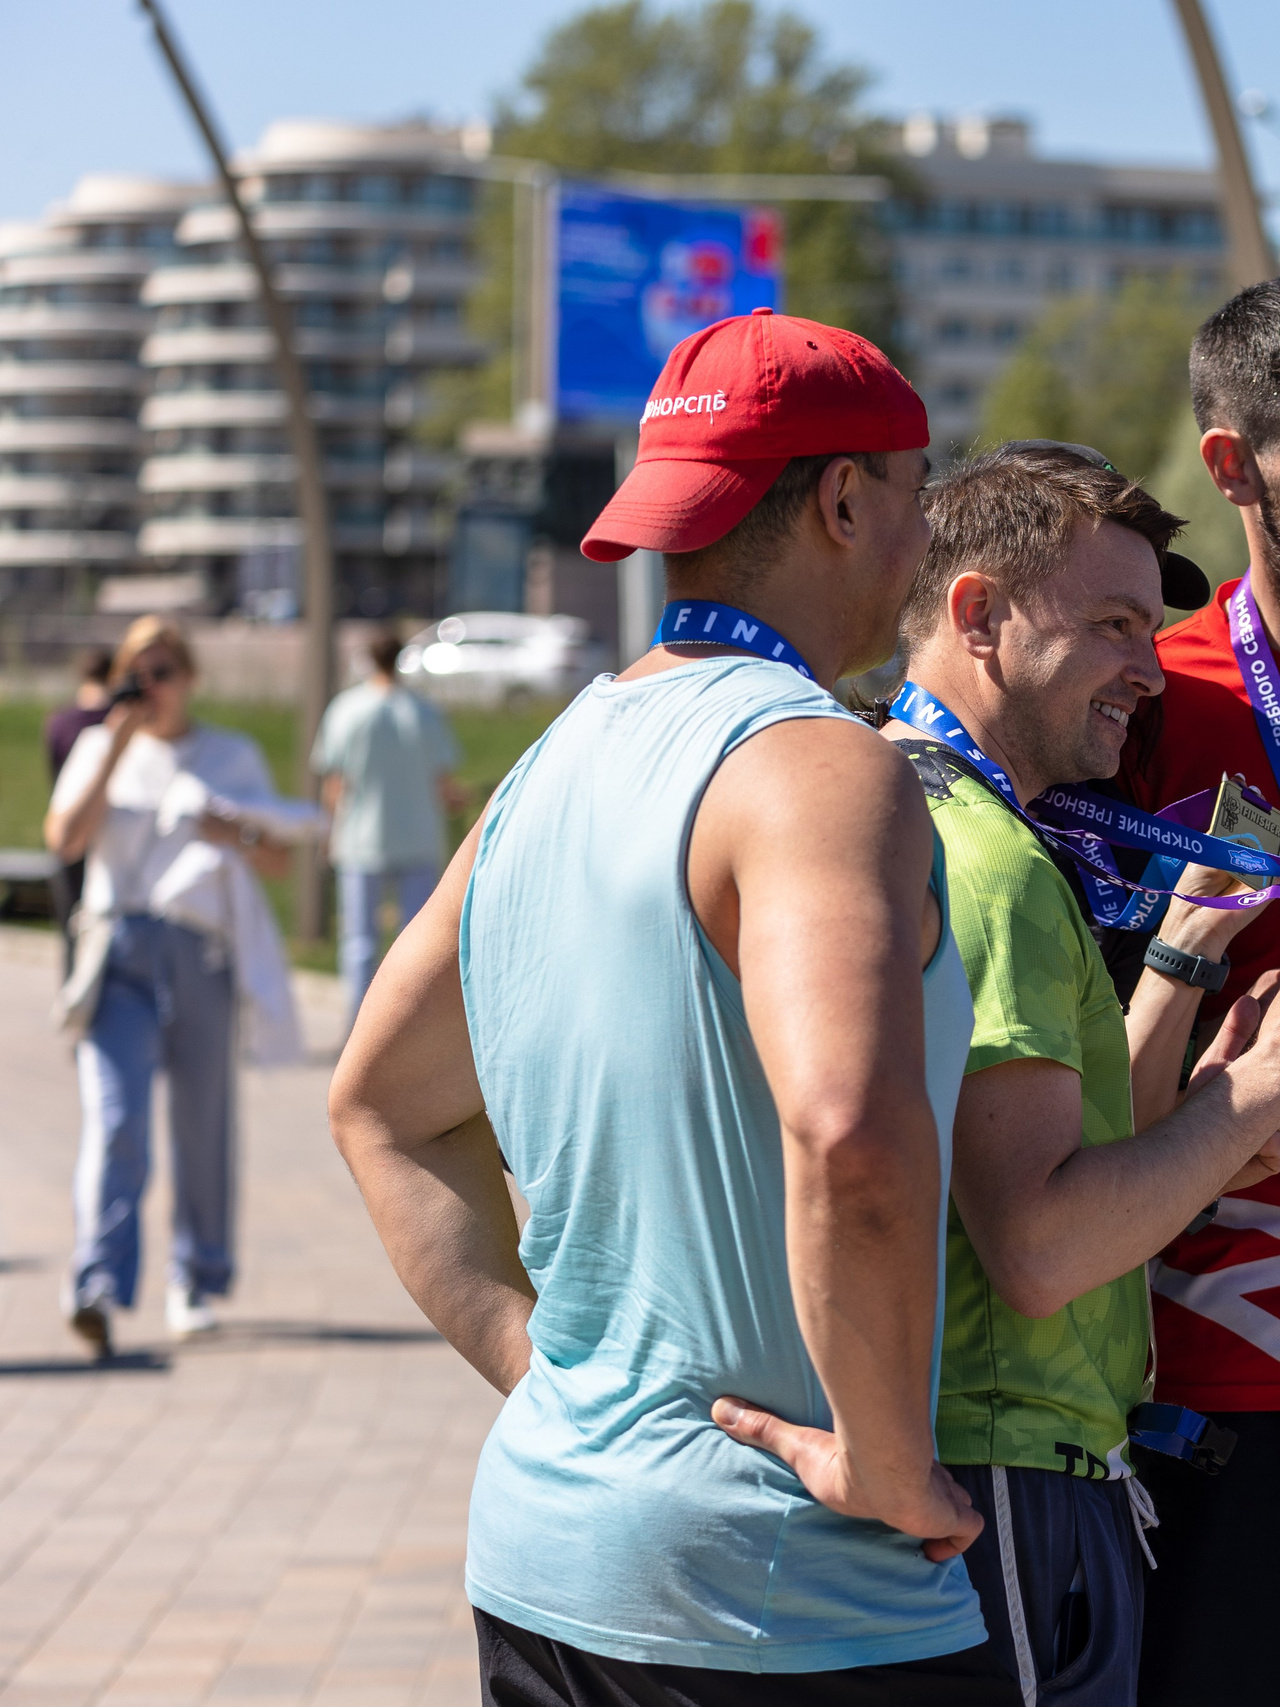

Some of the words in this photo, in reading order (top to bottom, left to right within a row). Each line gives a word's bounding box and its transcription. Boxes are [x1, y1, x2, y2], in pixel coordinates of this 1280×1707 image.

[639, 390, 727, 424] ОНОРСПБ
[1235, 589, 1259, 656] СЕЗОНА
[1118, 814, 1203, 854] ОТКРЫТИЕ
